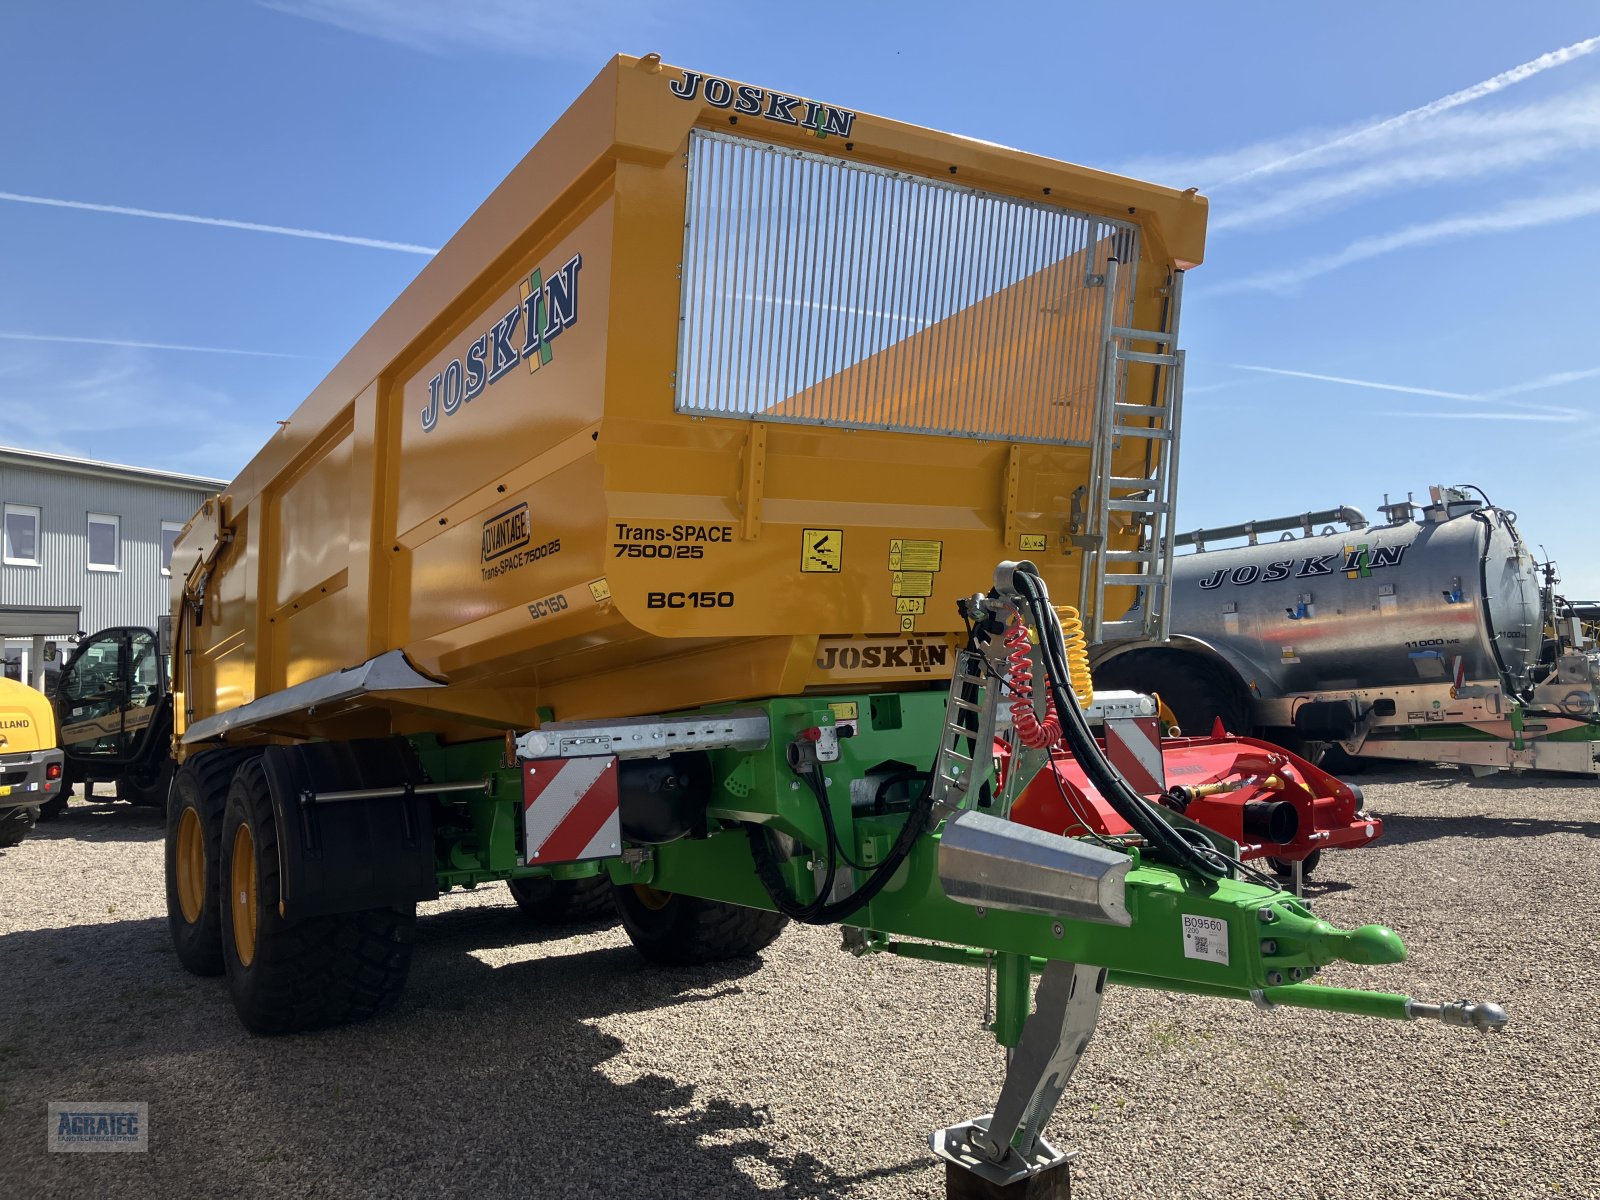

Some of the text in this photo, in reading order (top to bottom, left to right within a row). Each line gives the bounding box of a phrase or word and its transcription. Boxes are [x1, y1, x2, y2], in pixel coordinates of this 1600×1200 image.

[669, 70, 856, 137] JOSKIN
[420, 252, 582, 433] JOSKIN
[481, 511, 527, 565] ADVANTAGE
[614, 523, 733, 543] Trans-SPACE
[613, 543, 704, 560] 7500/25
[481, 553, 523, 581] Trans-SPACE
[1199, 543, 1411, 589] JOSKIN
[527, 594, 569, 619] BC150
[647, 591, 735, 609] BC150
[1404, 638, 1444, 649] 11000
[816, 644, 949, 670] JOSKIN
[1184, 917, 1222, 932] B09560
